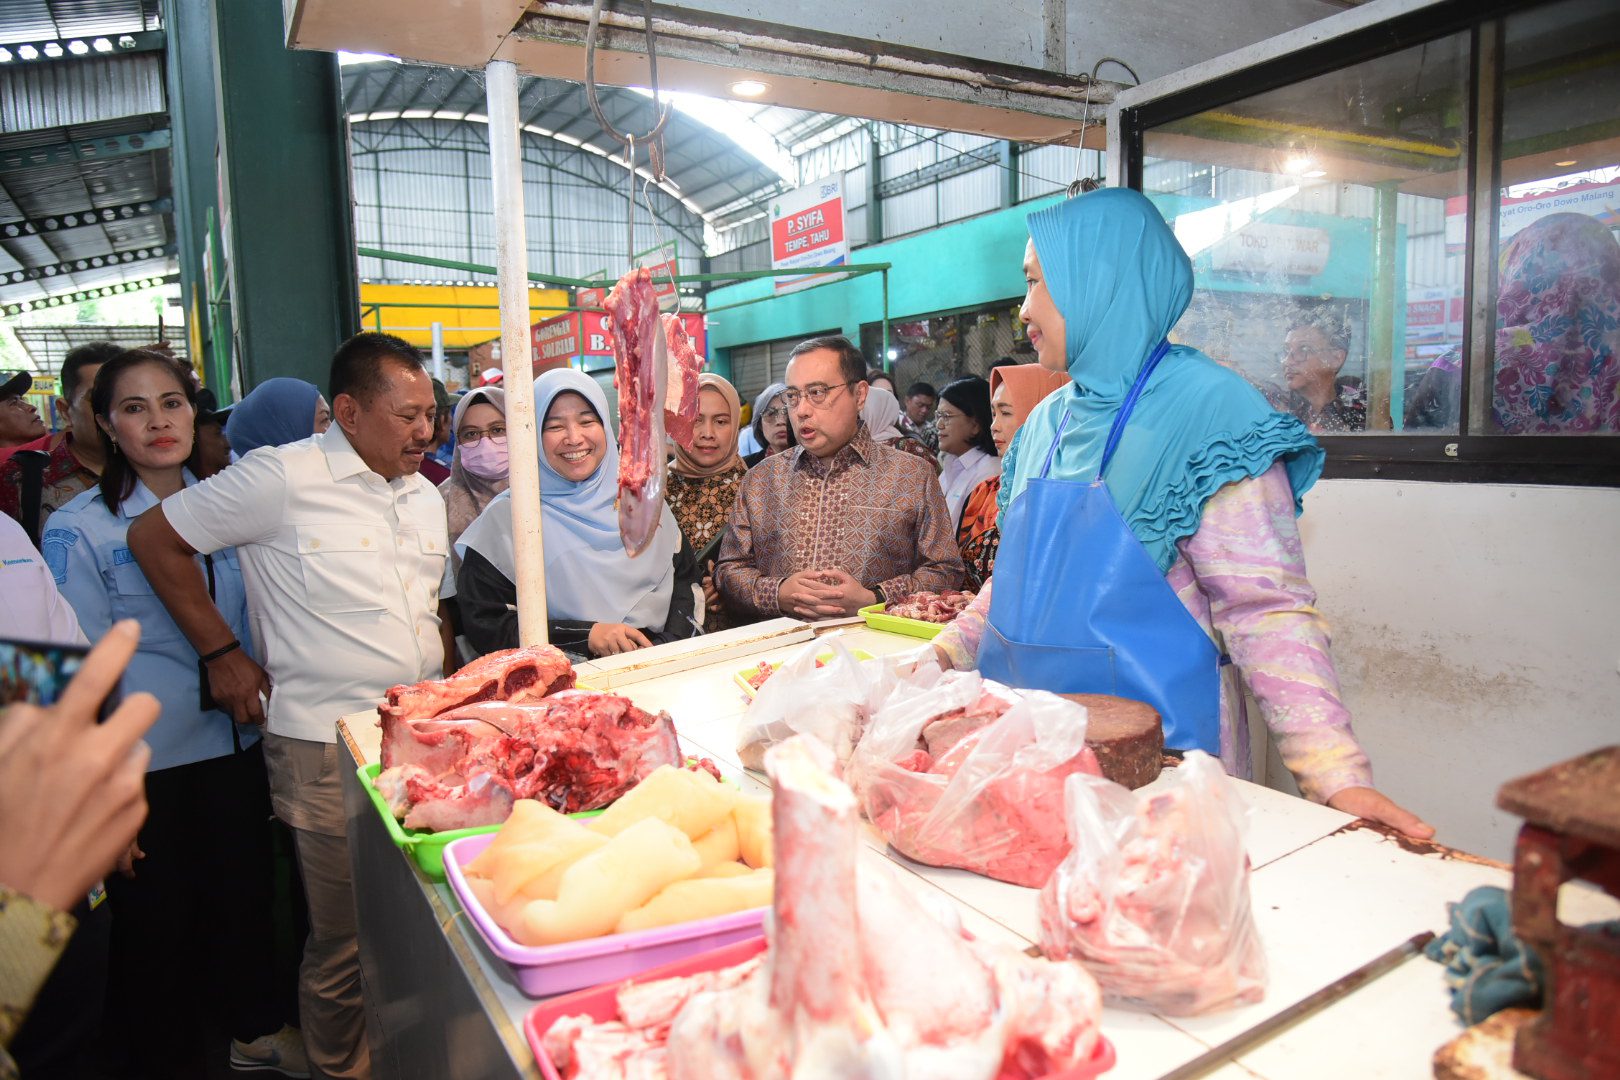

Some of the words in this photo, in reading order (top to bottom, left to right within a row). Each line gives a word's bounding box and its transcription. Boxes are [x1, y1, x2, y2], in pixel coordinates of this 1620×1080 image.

[1517, 201, 1551, 214] Oro-Oro
[1554, 197, 1579, 208] Dowo
[1581, 190, 1615, 203] Malang
[787, 218, 796, 234] P.
[797, 209, 824, 231] SYIFA
[784, 235, 809, 253] TEMPE,
[810, 228, 830, 244] TAHU
[1240, 233, 1268, 249] TOKO
